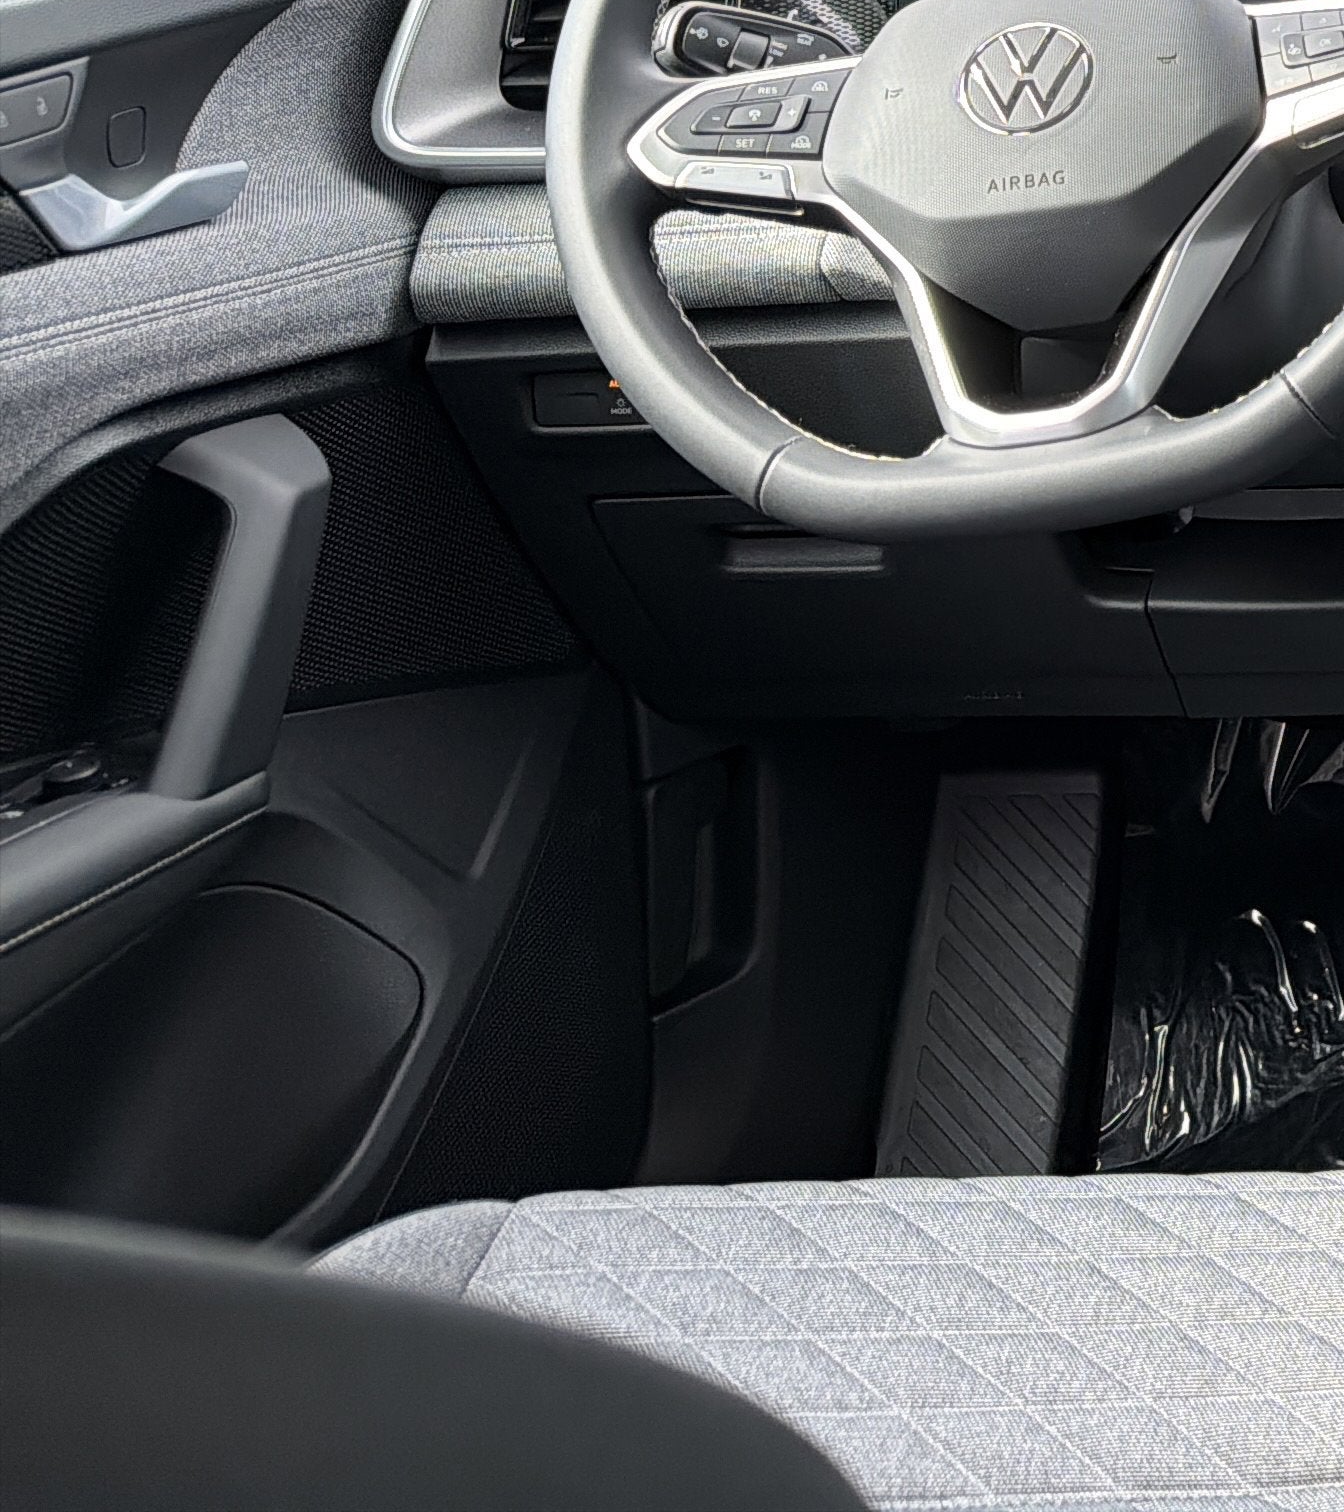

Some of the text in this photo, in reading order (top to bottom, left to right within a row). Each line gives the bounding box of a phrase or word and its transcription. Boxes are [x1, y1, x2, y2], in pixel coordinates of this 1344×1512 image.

[757, 86, 778, 95] RES
[735, 138, 755, 149] SET
[791, 141, 812, 149] MODE
[986, 169, 1066, 194] AIRBAG
[610, 407, 633, 415] MODE
